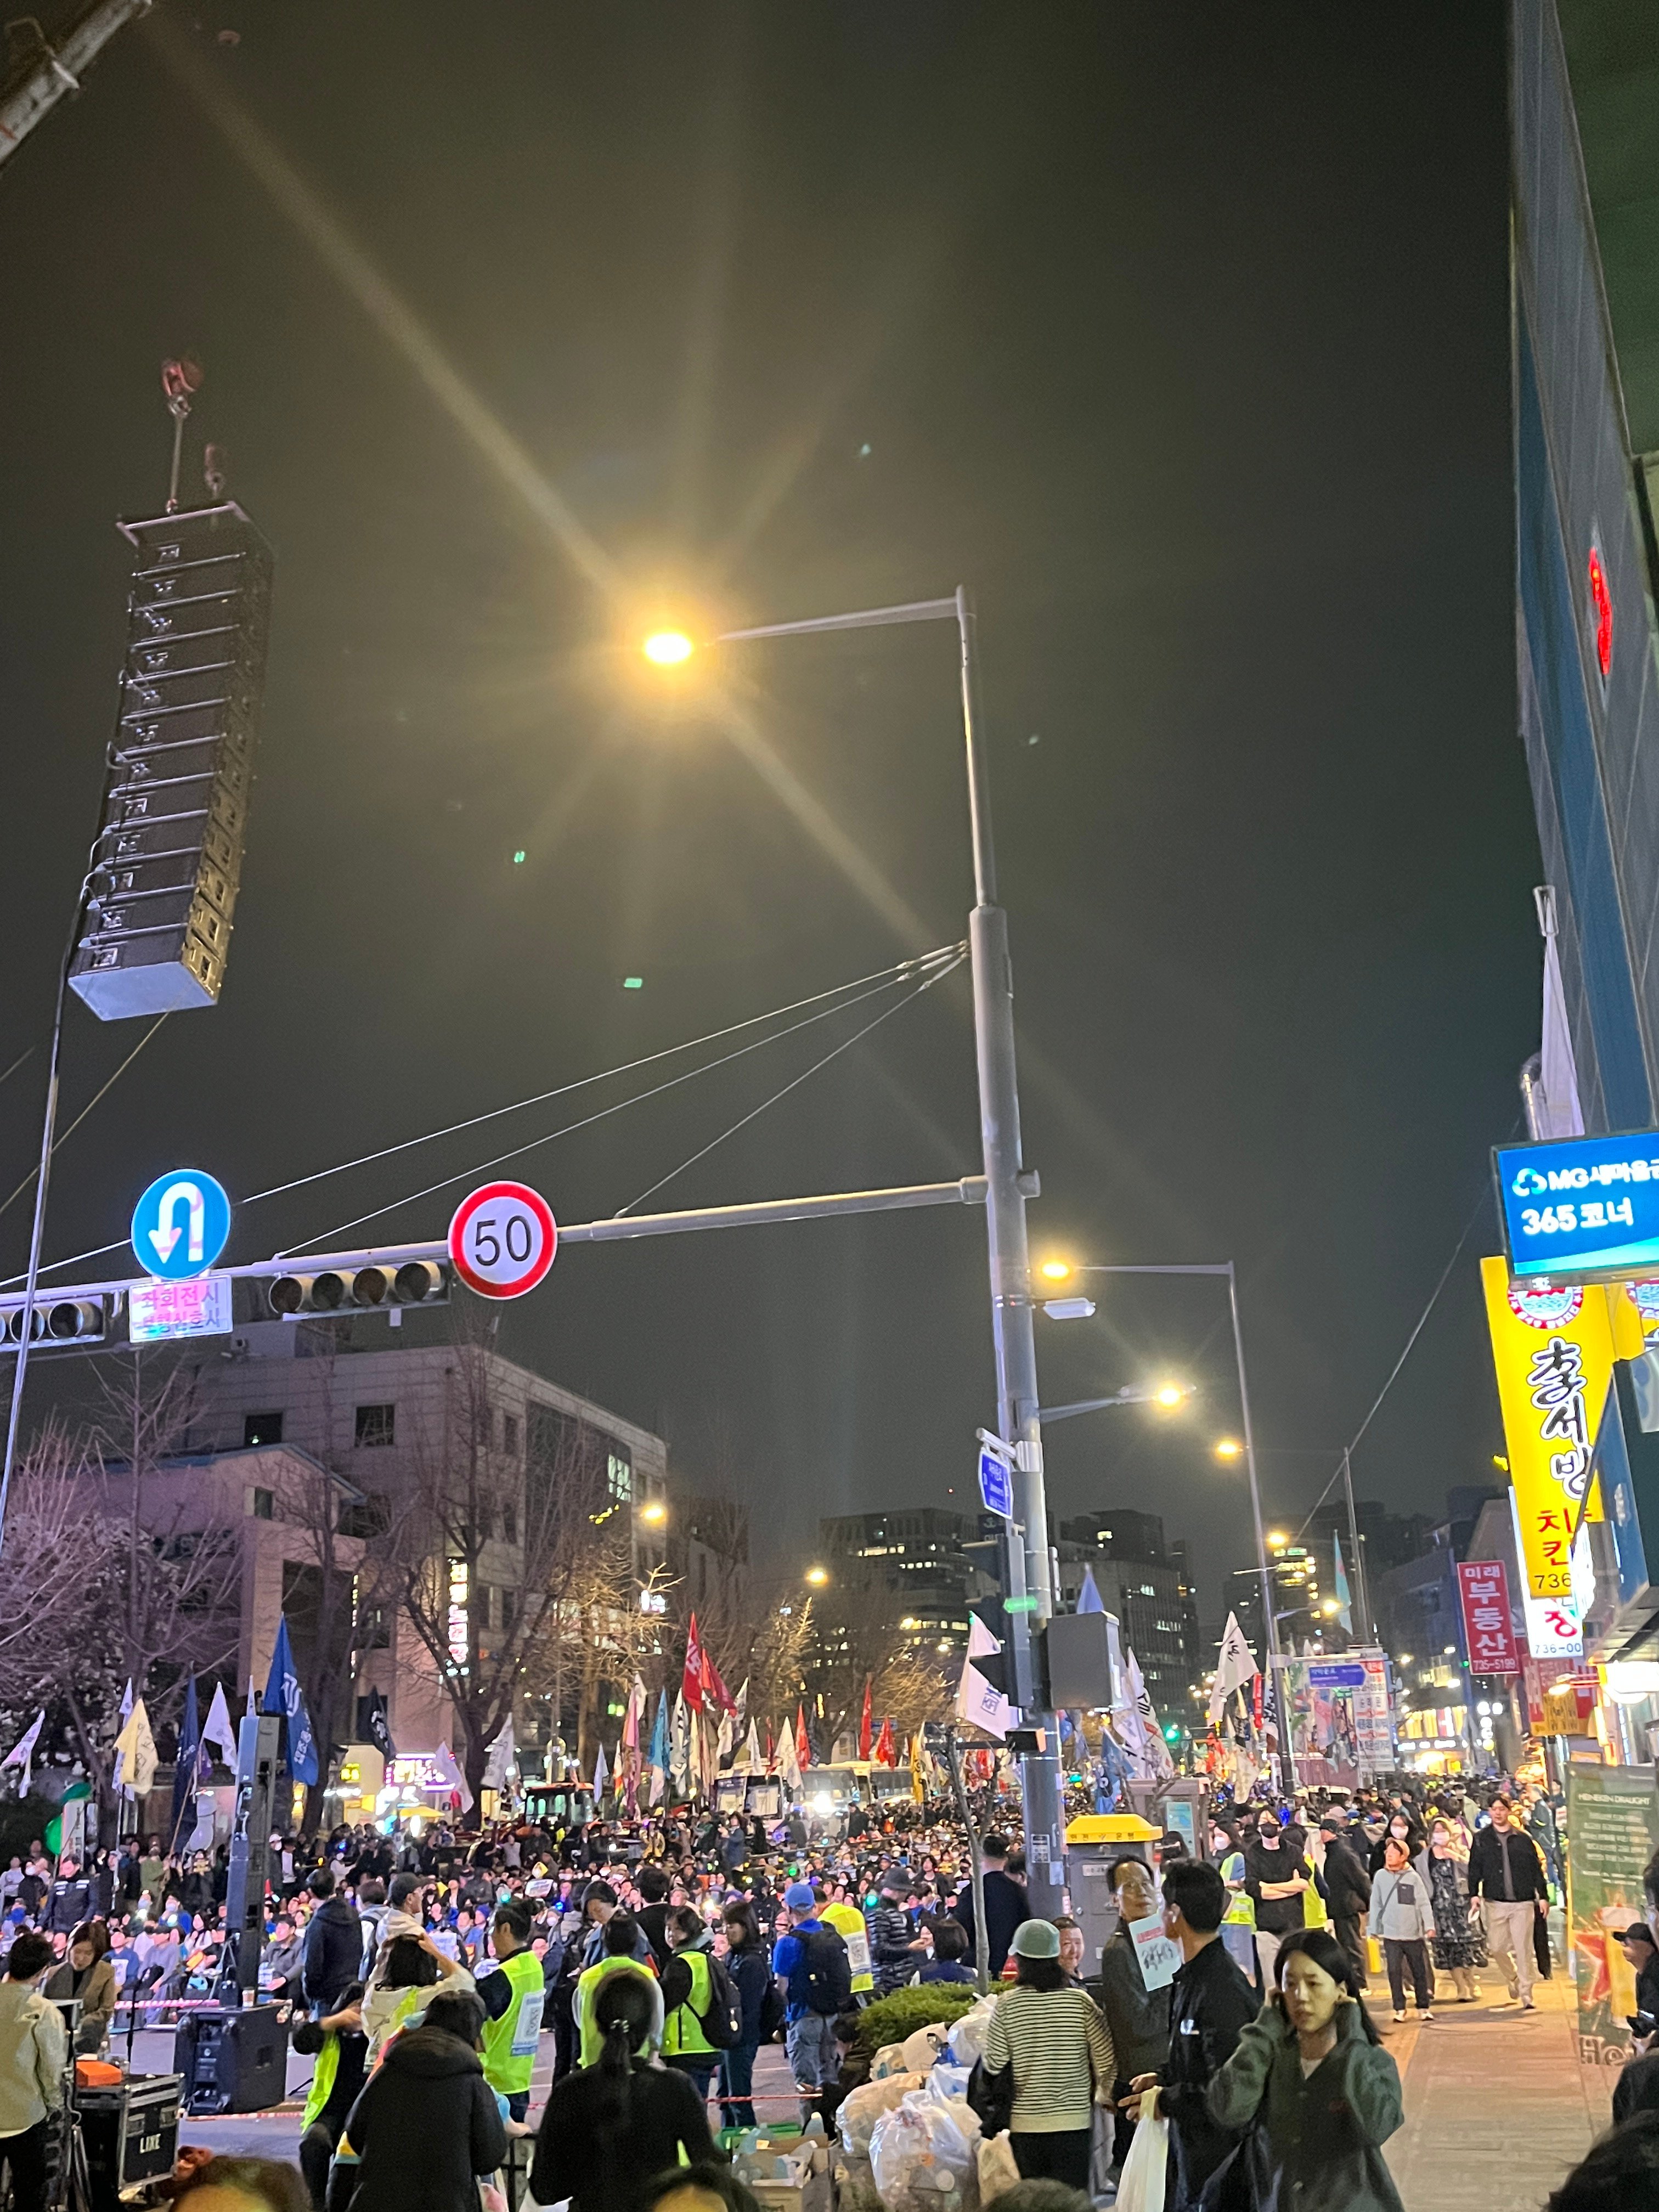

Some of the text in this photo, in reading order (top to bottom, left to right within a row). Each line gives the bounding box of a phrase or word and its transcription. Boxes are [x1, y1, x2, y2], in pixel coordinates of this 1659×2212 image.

[475, 1215, 532, 1266] 50
[141, 1282, 219, 1310] 좌회전시
[1465, 1565, 1500, 1579] 미래
[1469, 1581, 1508, 1656] 부동산
